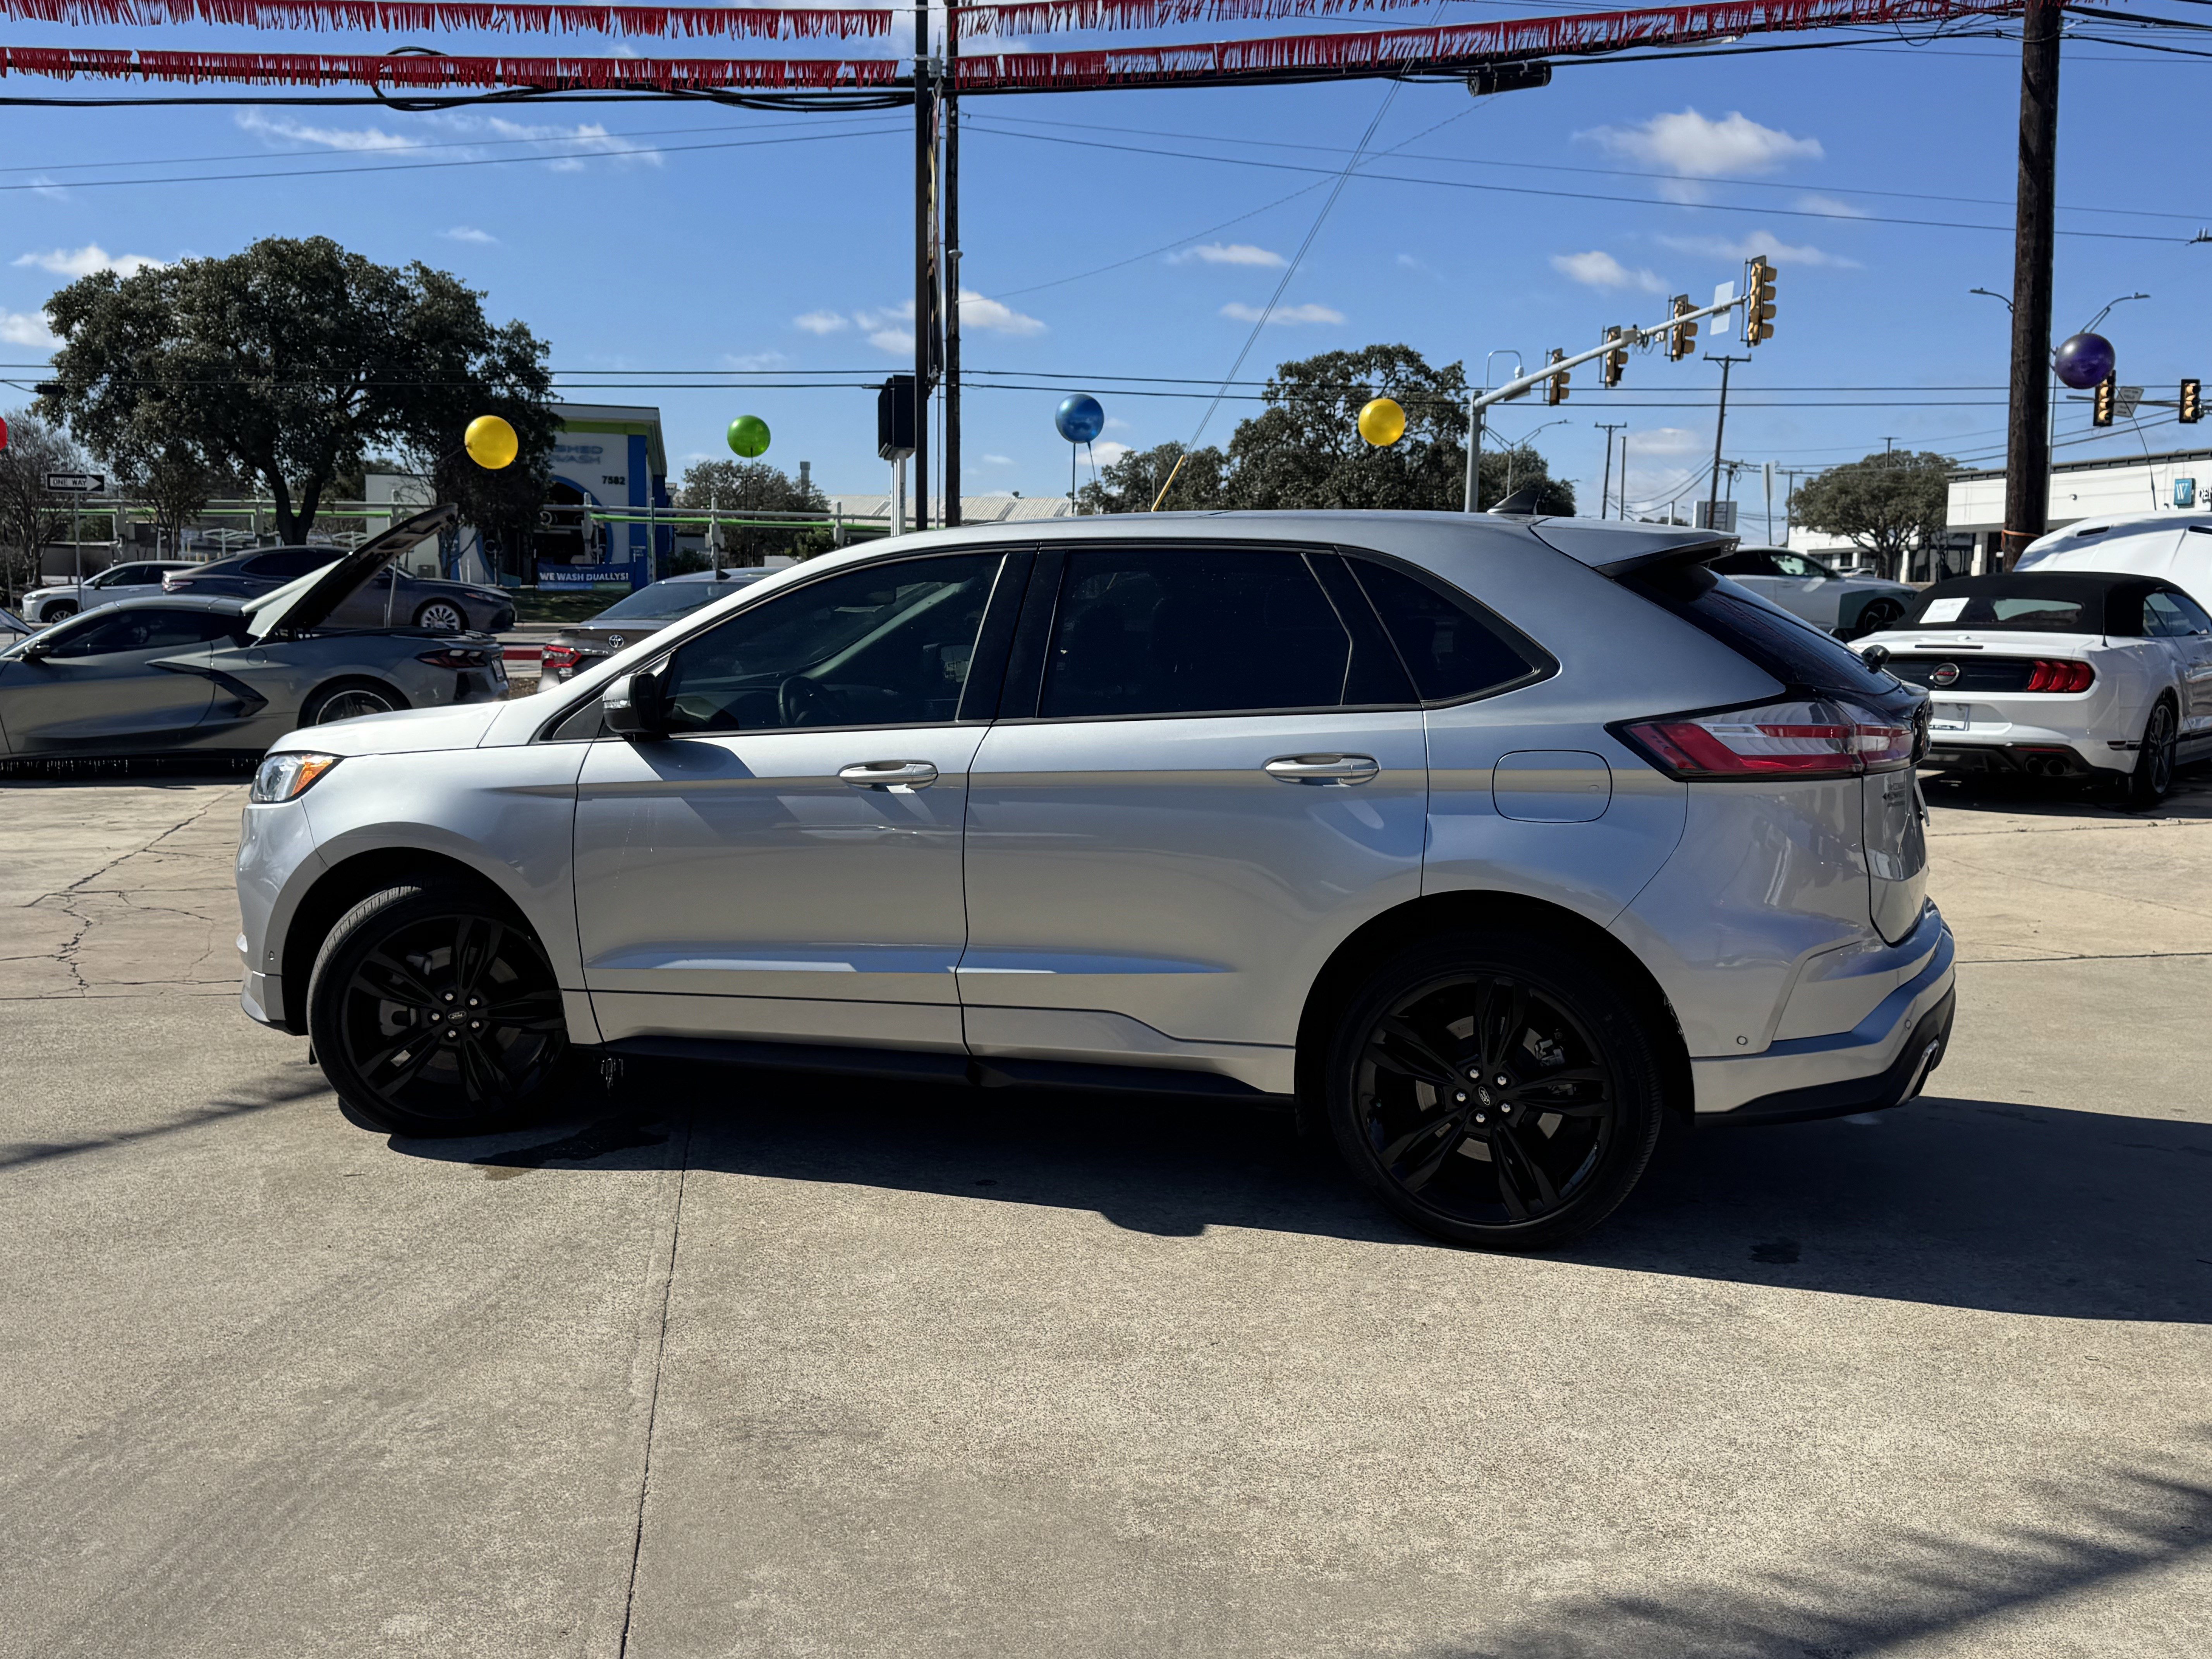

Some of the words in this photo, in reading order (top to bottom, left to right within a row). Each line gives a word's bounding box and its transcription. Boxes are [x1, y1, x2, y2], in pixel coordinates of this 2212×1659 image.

[602, 476, 625, 485] 7582
[539, 572, 555, 580] WE
[556, 572, 584, 581] WASH
[586, 572, 629, 581] DUALLYS!
